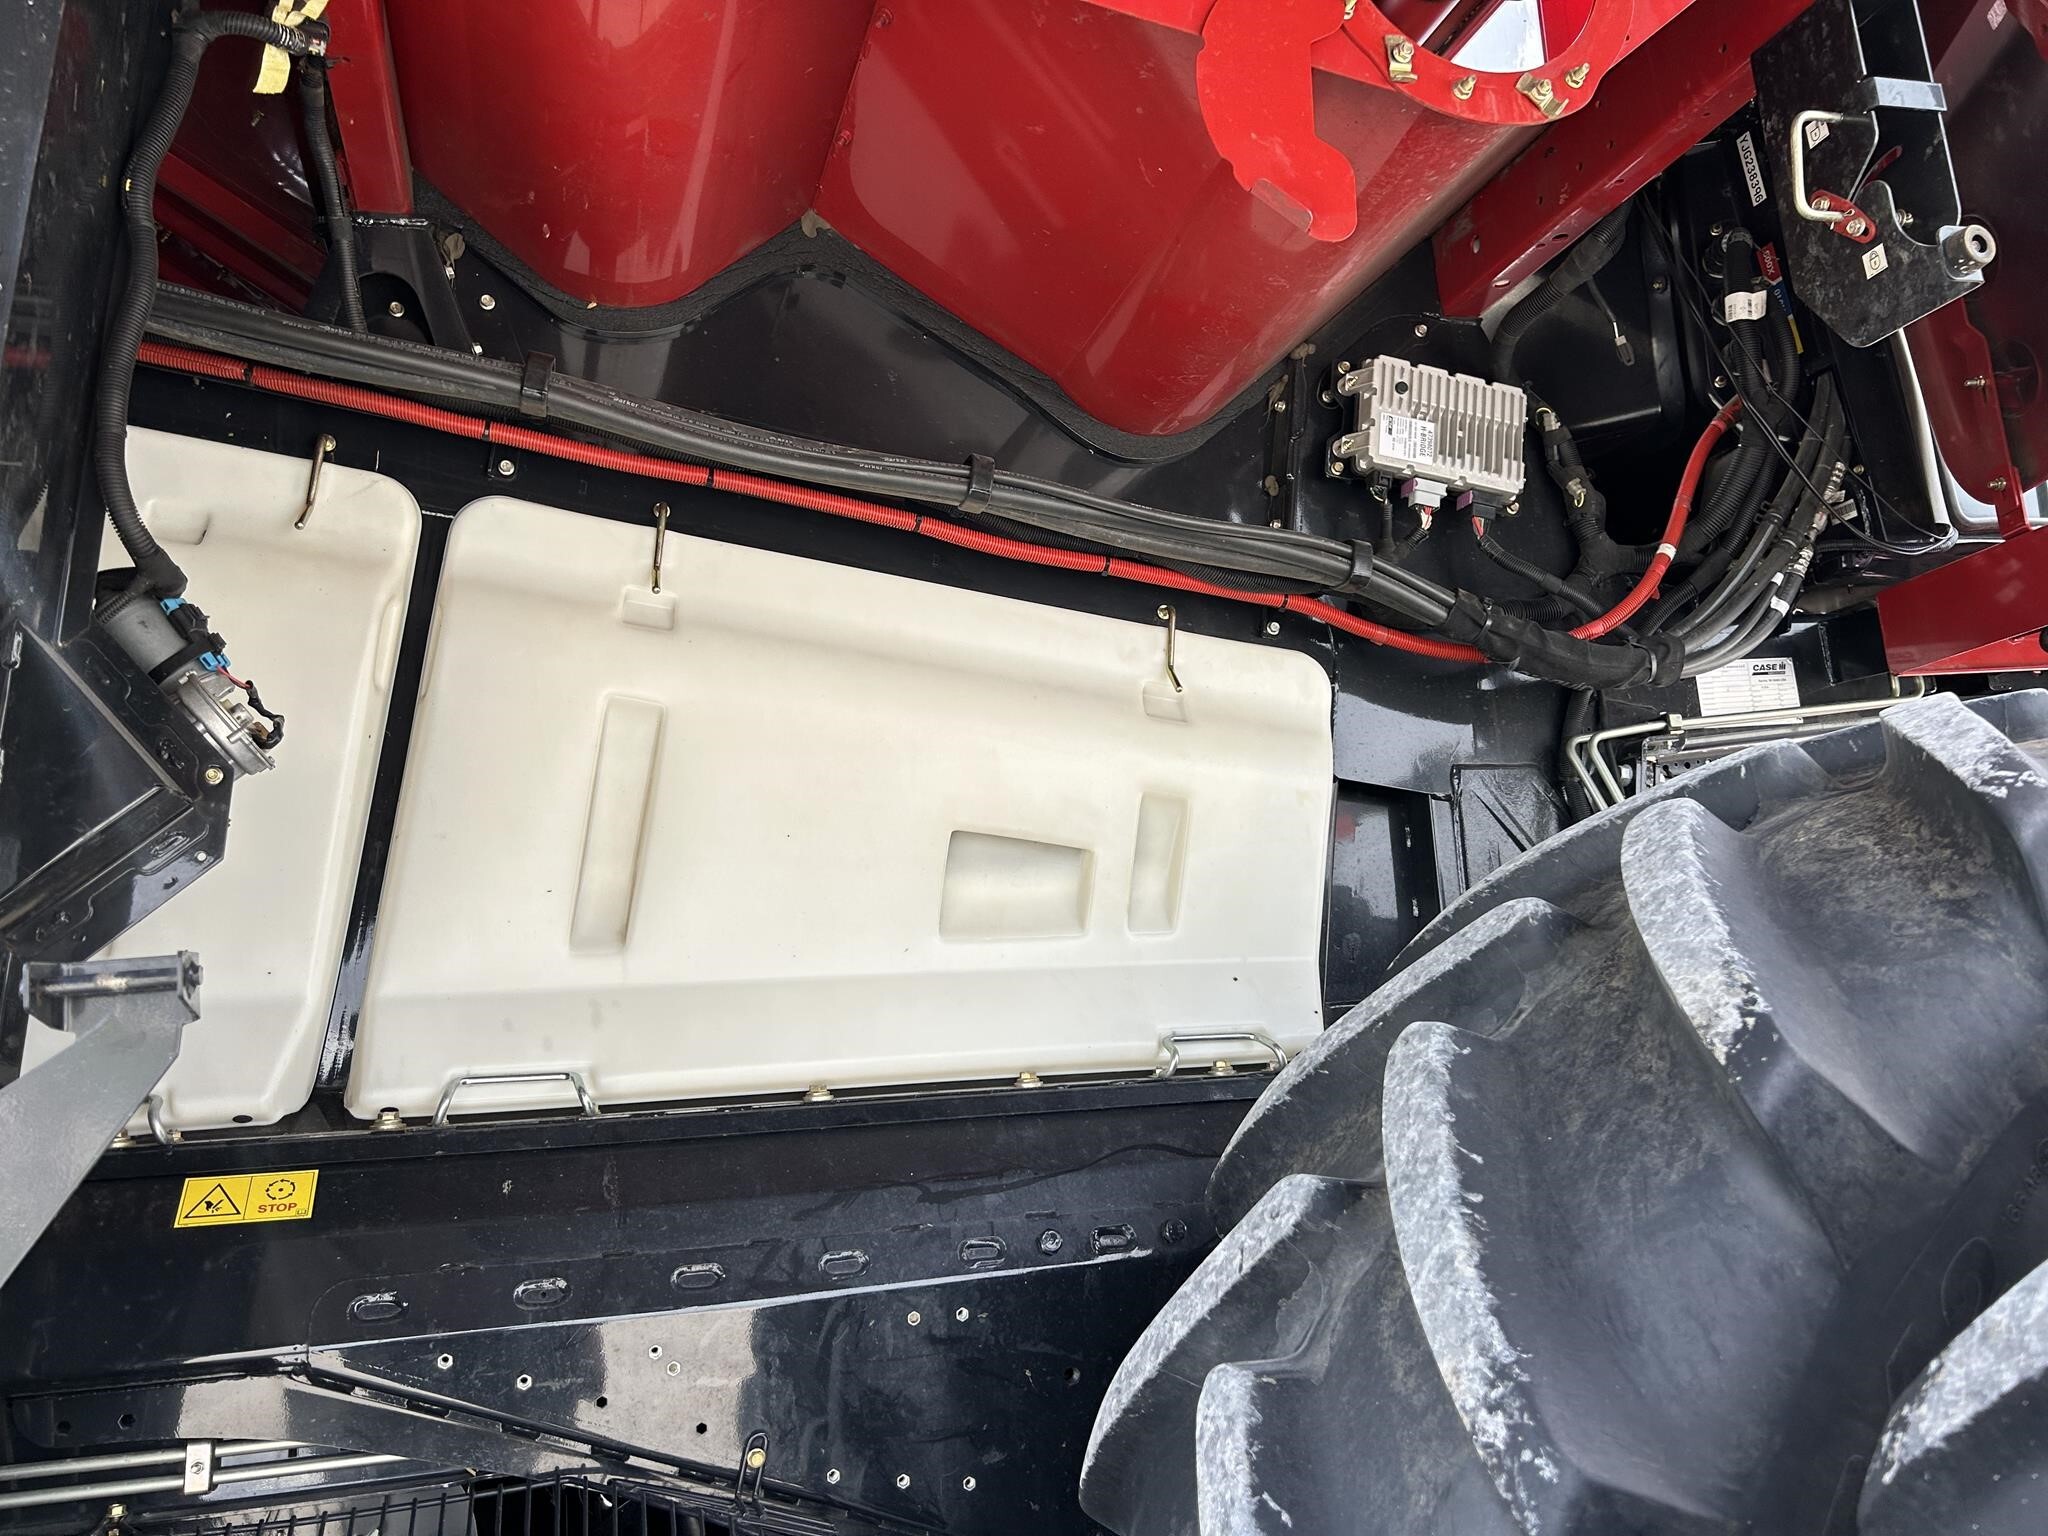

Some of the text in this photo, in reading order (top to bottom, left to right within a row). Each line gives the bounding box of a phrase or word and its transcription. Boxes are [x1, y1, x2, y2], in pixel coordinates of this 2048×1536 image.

[1739, 134, 1764, 203] YJG238396
[1752, 663, 1777, 672] CASE
[257, 1202, 298, 1214] STOP
